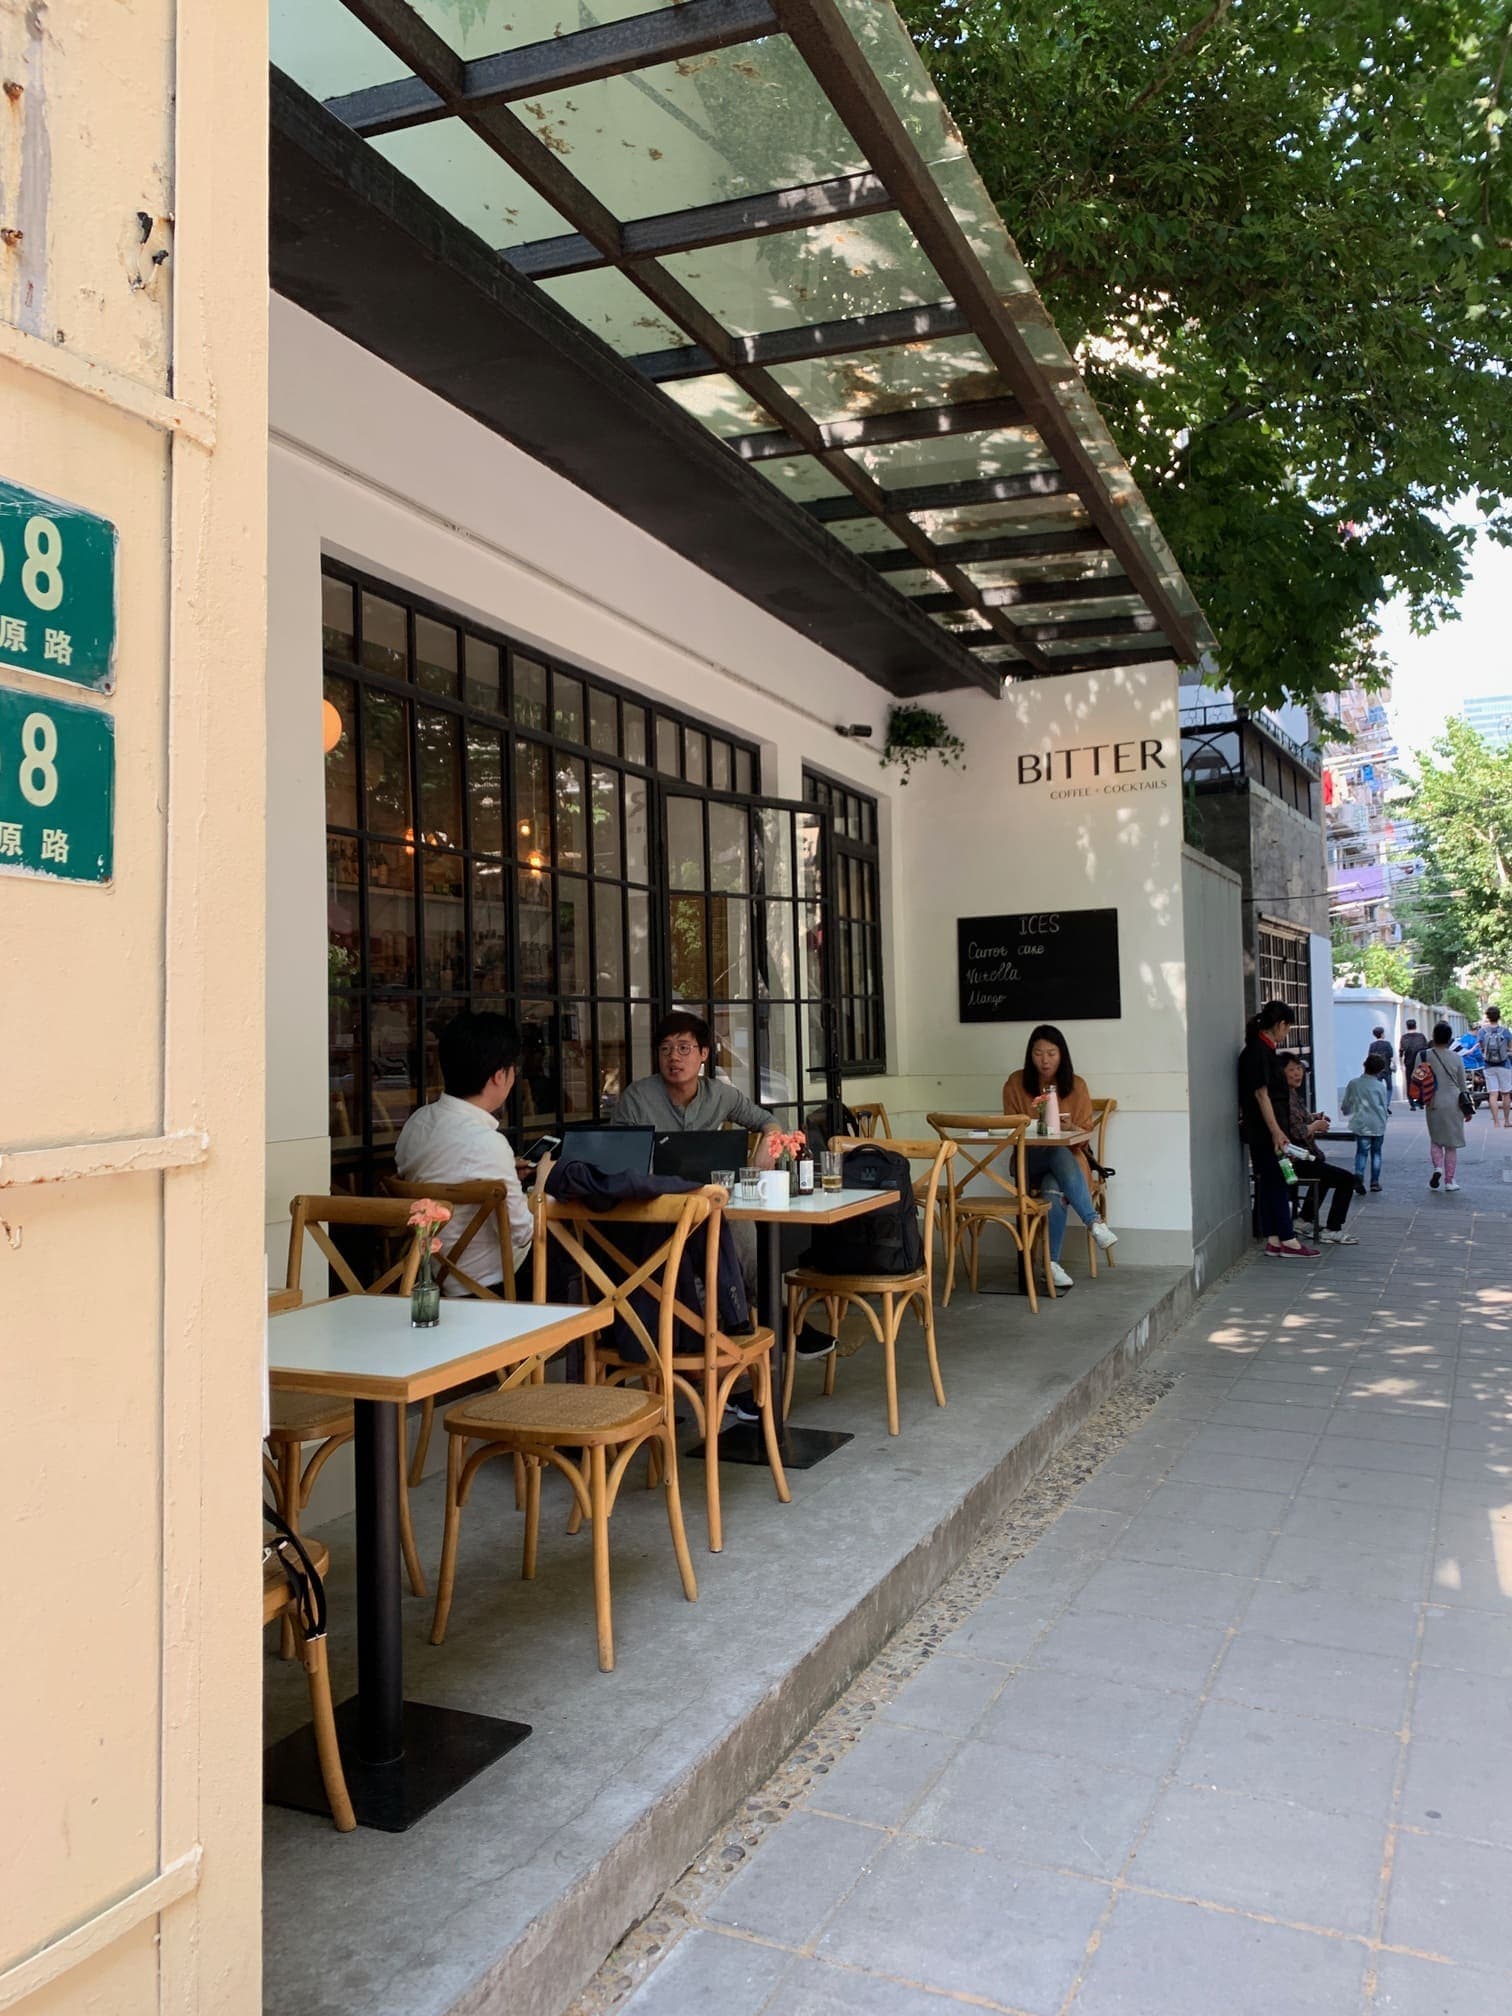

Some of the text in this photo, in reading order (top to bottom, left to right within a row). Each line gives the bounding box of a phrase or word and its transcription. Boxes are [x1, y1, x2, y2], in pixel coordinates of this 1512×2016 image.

[0, 515, 64, 611] 8
[0, 615, 73, 666] 原路
[1017, 739, 1166, 785] BITTER
[1050, 779, 1168, 800] COFFEE COCKTAILS
[0, 821, 70, 863] 原路
[1018, 913, 1060, 936] ICES
[968, 941, 1008, 960] Carrot
